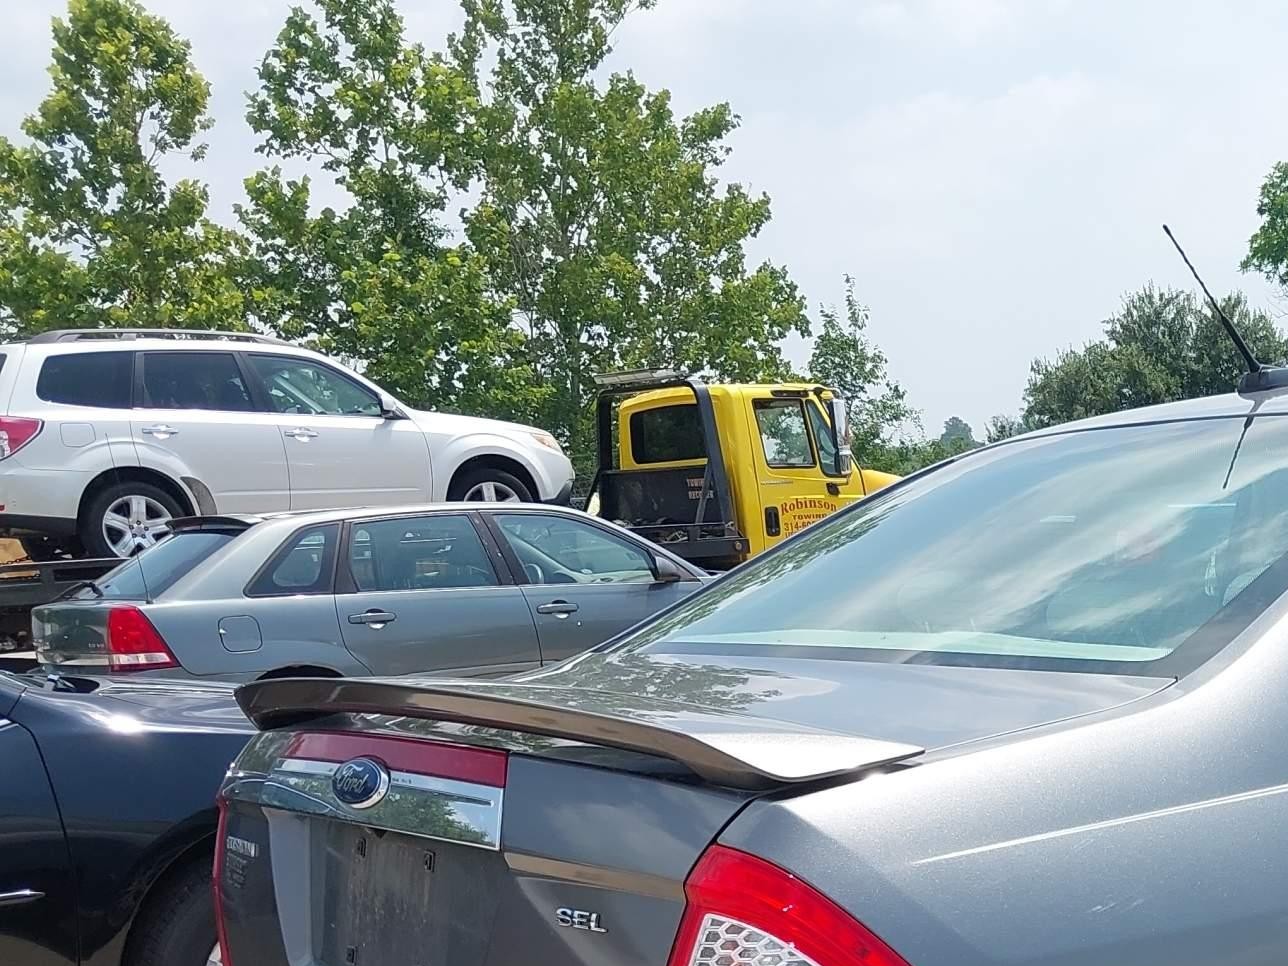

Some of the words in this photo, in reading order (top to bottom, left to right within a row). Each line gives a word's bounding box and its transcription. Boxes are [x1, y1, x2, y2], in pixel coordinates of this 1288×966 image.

[780, 497, 837, 516] Robinson
[335, 763, 371, 794] Ford
[555, 907, 608, 933] SEL
